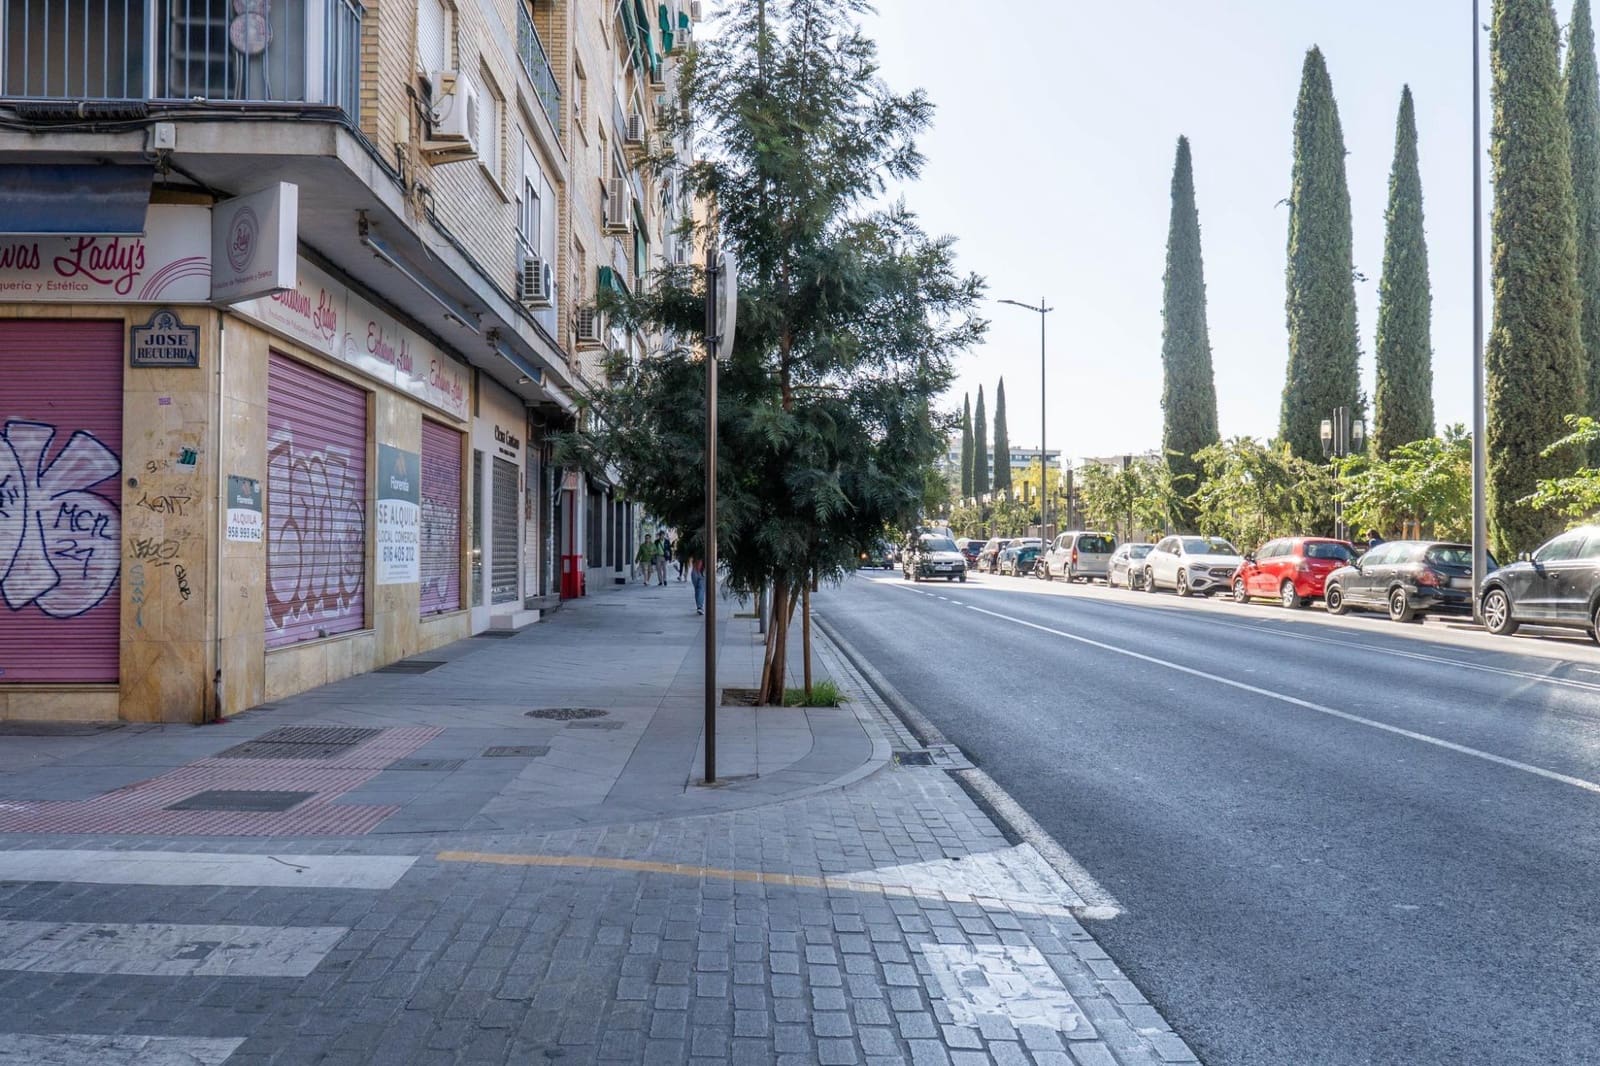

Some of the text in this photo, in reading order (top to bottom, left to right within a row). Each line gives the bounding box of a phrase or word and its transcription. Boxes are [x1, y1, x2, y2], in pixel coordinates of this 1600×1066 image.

[47, 280, 89, 291] Estética
[144, 334, 189, 346] JOSE
[138, 347, 195, 361] RECUERDA
[233, 511, 257, 525] ALQUILA
[379, 503, 418, 528] SE ALQUILA
[378, 530, 418, 544] LOCAL COMERCIAL
